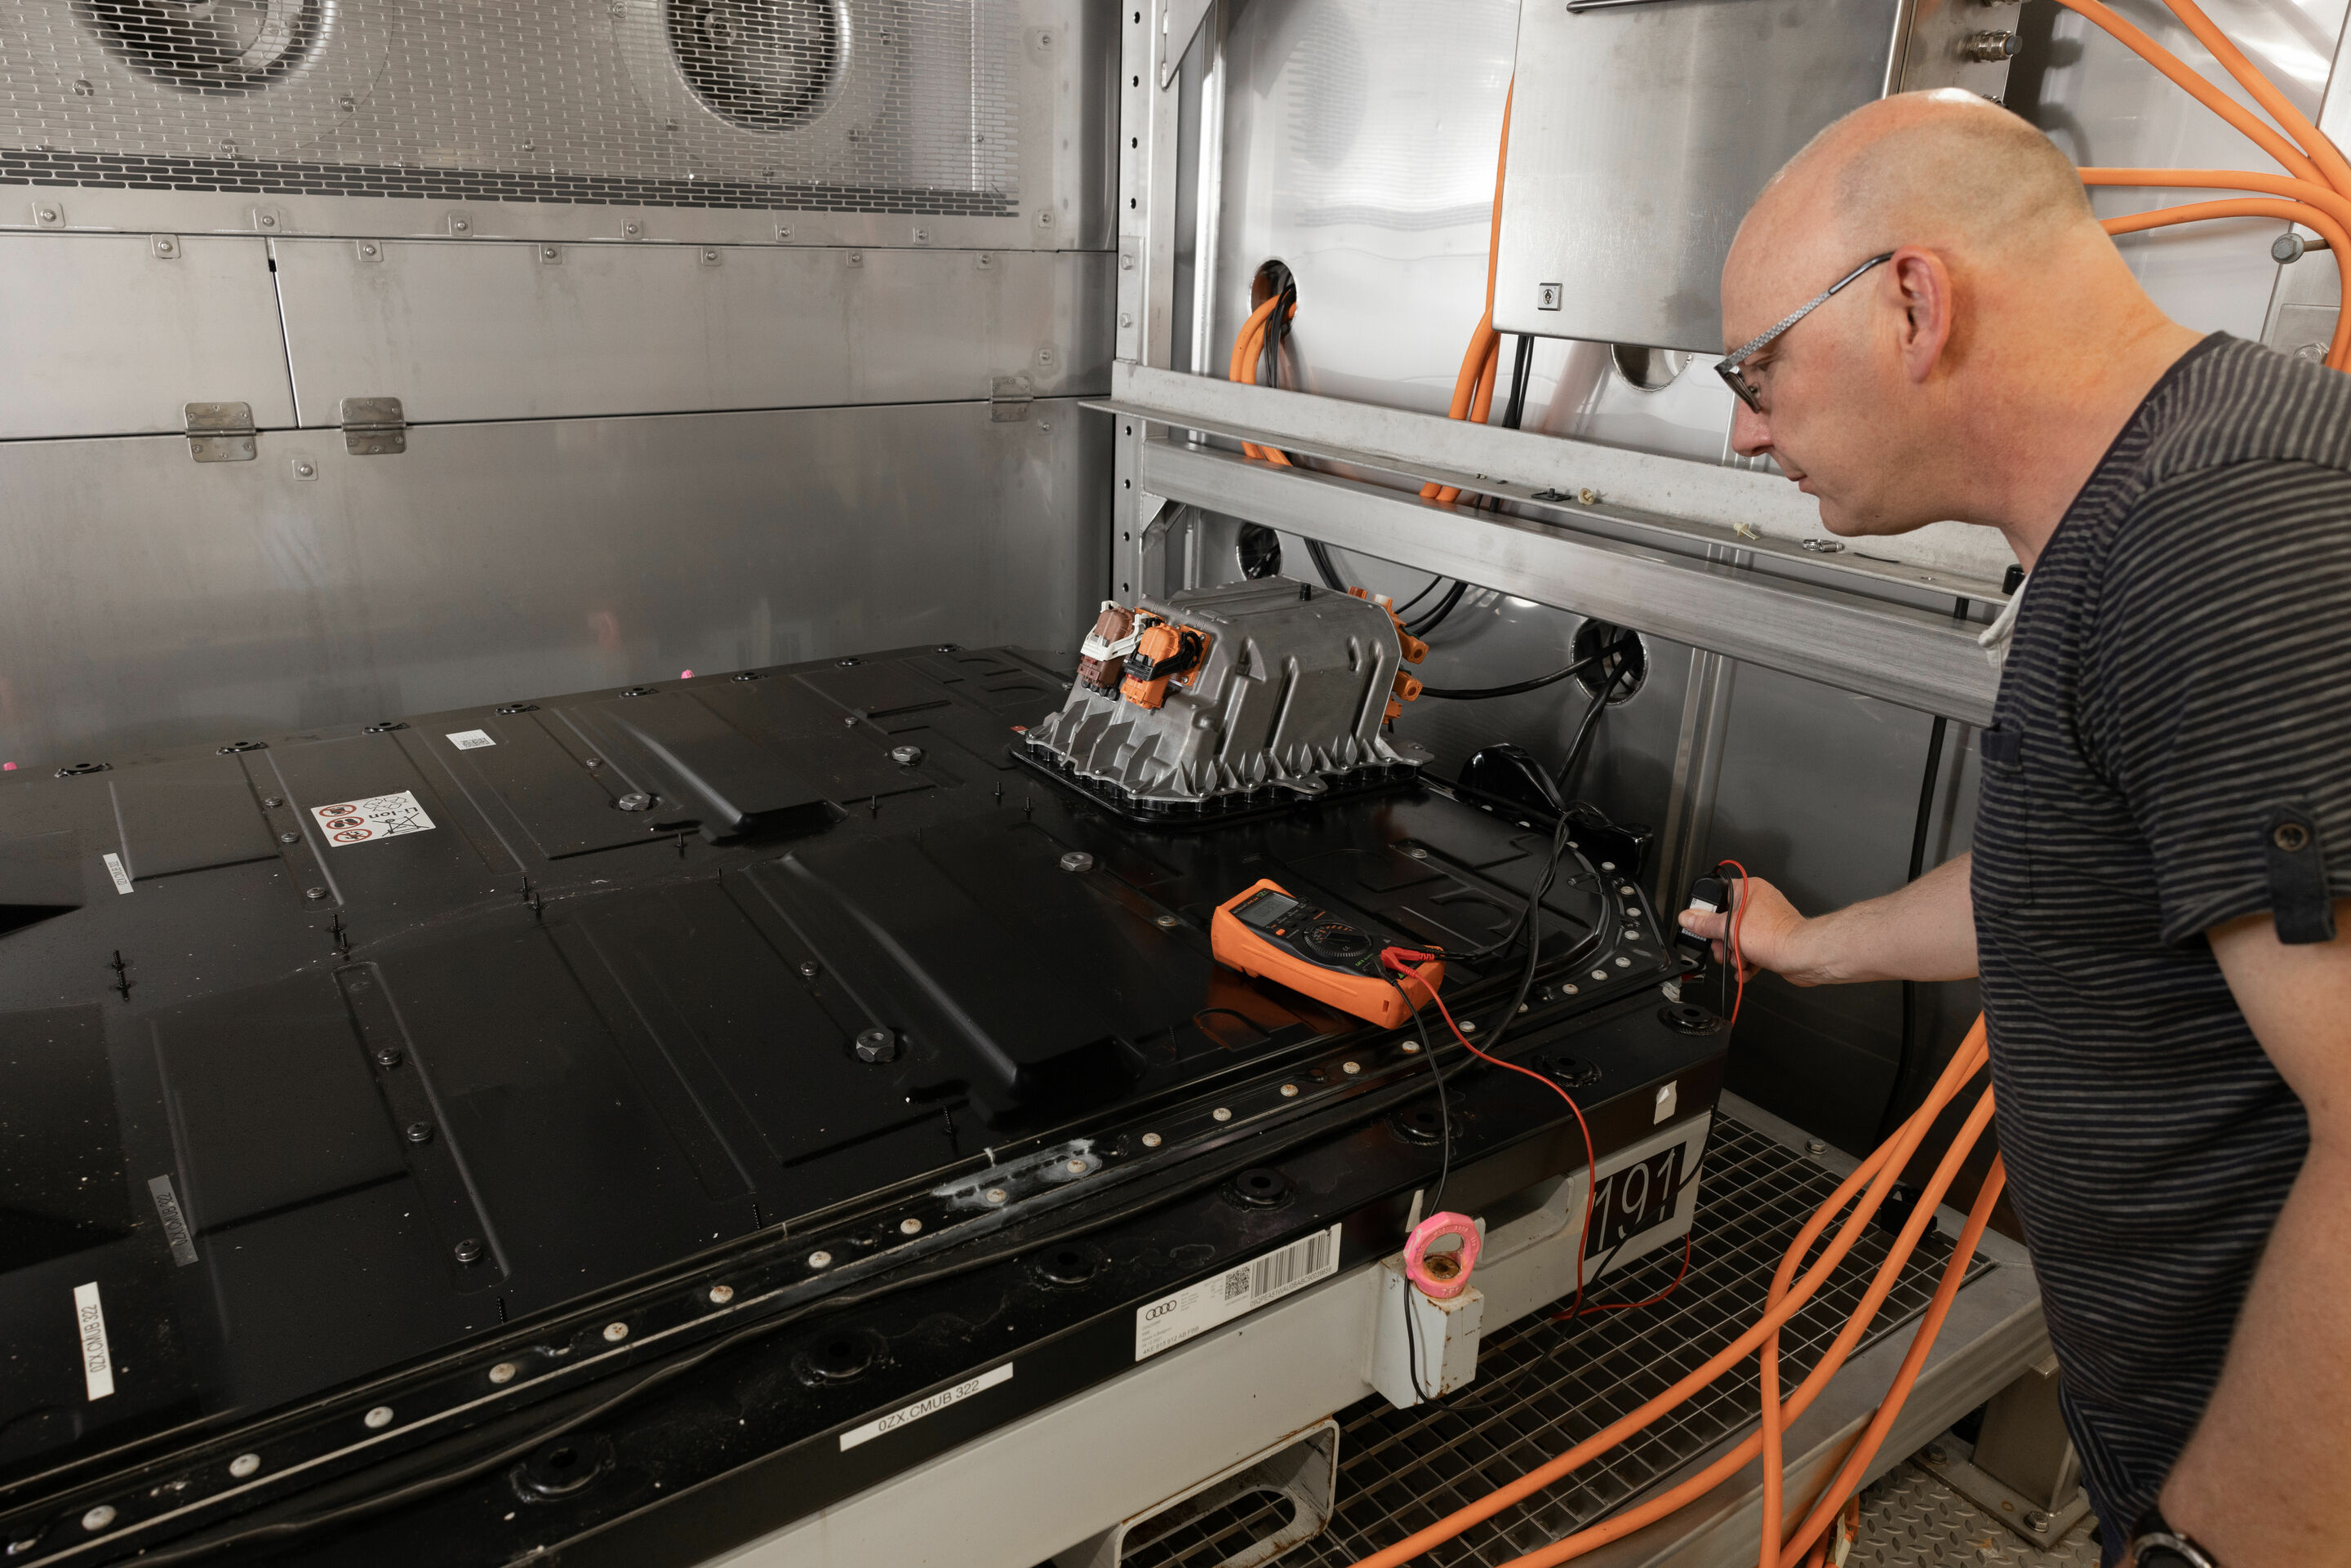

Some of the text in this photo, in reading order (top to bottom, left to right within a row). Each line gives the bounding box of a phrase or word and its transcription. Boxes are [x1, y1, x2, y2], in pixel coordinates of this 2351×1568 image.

[368, 806, 418, 819] Li-Ion
[1594, 1148, 1676, 1252] 191
[81, 1304, 99, 1323] 322
[878, 1379, 980, 1432] 0ZX.CMUB 322
